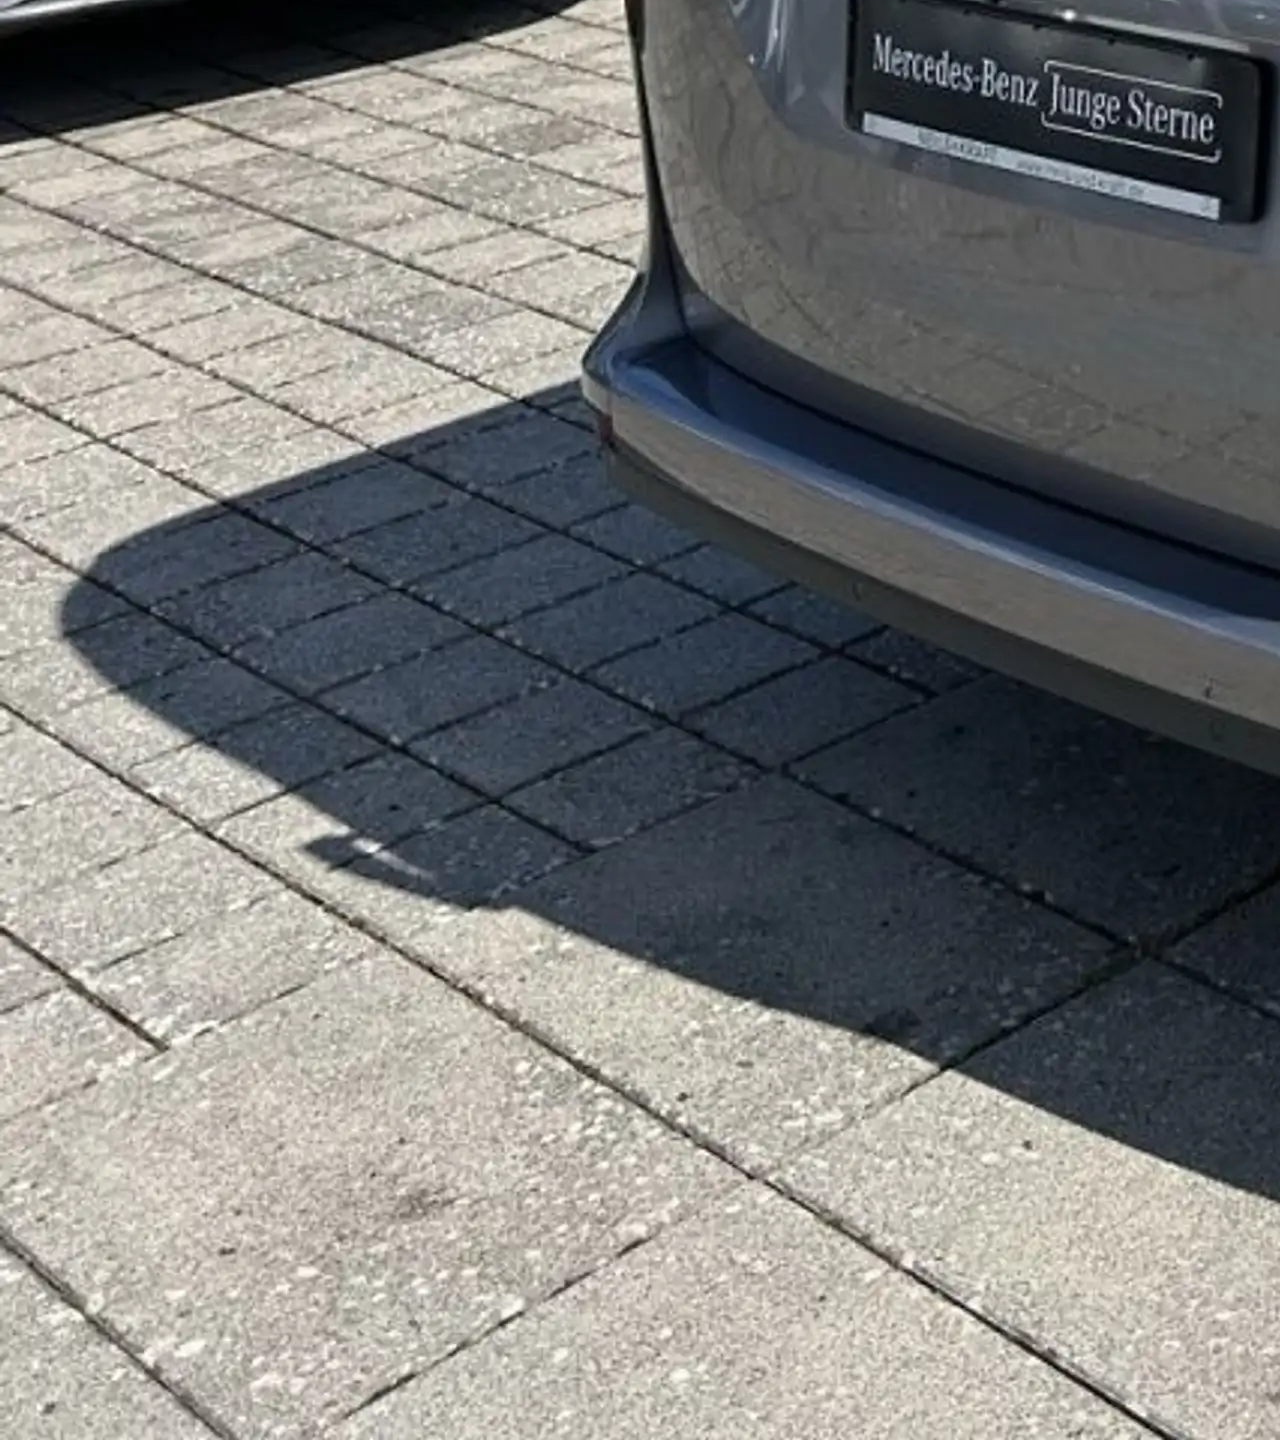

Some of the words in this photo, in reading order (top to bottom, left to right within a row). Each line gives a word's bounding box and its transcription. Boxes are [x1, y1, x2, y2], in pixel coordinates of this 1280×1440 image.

[872, 33, 1041, 107] Mercedes-Benz
[1049, 72, 1121, 131] Junge
[1126, 87, 1216, 145] Sterne
